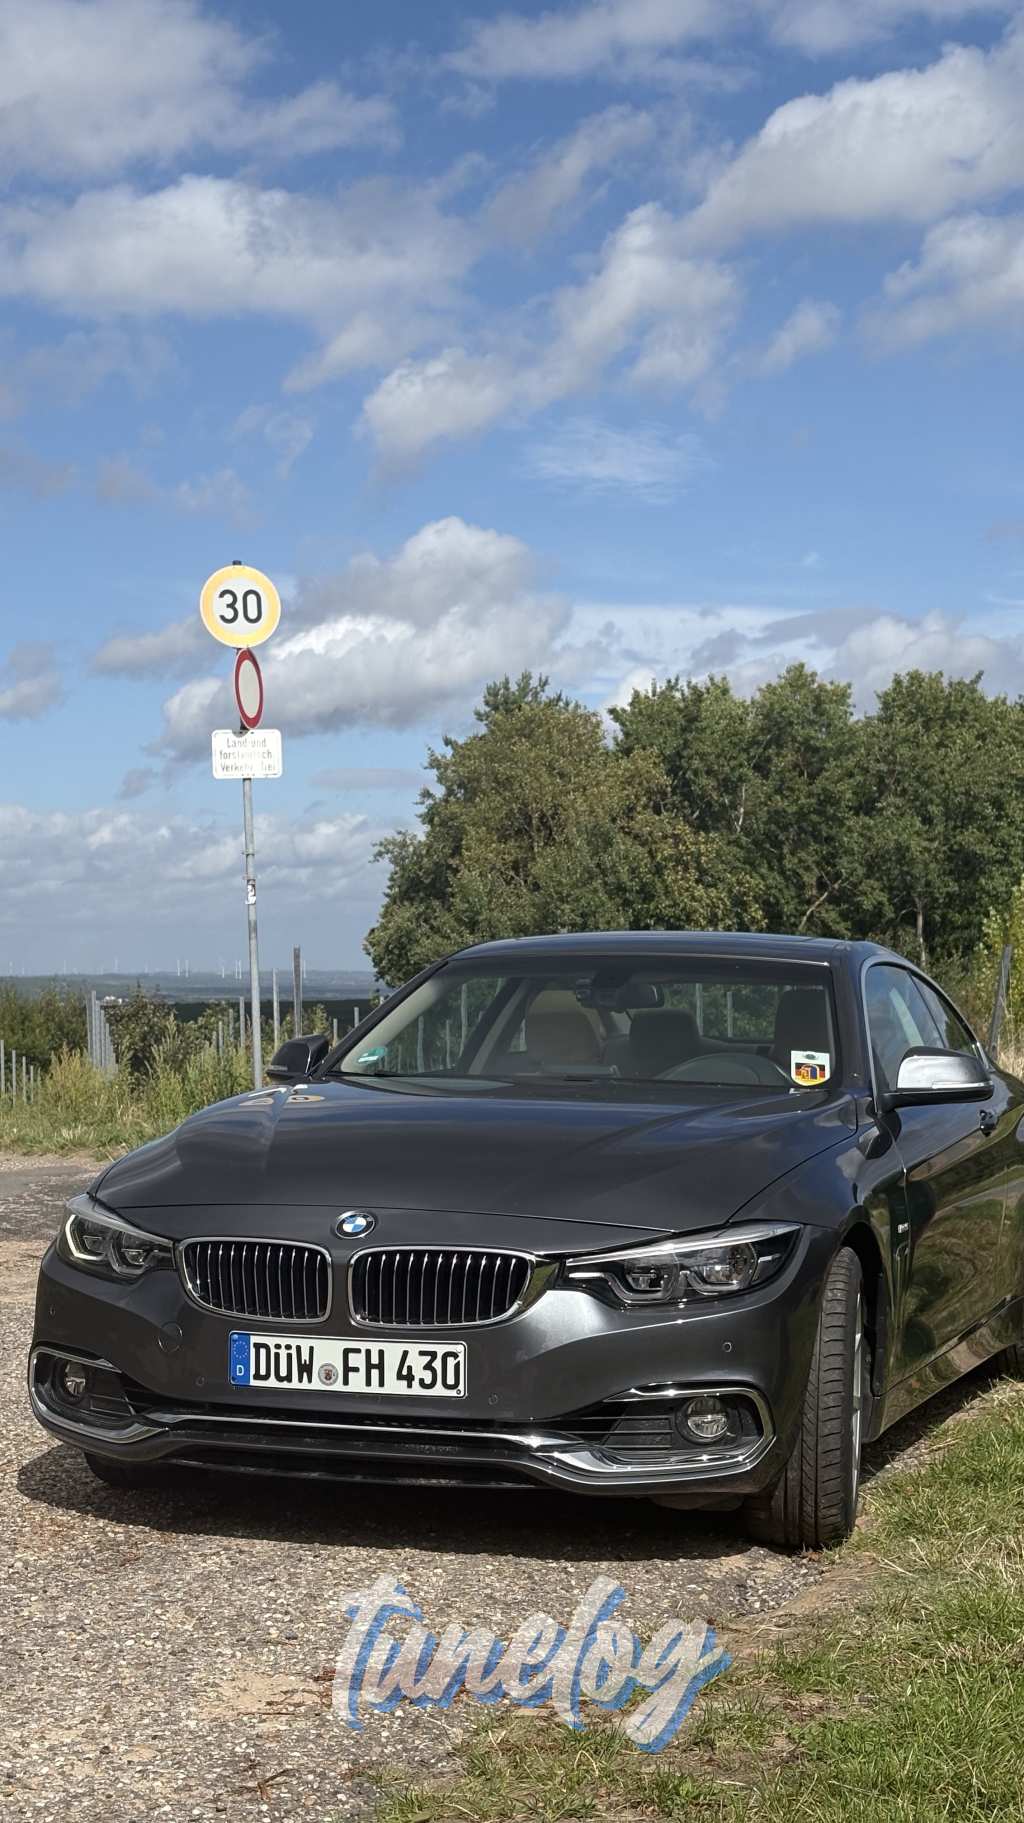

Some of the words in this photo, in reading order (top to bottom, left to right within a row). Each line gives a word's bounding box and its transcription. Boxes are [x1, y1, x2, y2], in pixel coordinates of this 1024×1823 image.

[218, 589, 263, 624] 30
[236, 1364, 245, 1376] D
[342, 1347, 385, 1387] FH
[396, 1350, 461, 1390] 430
